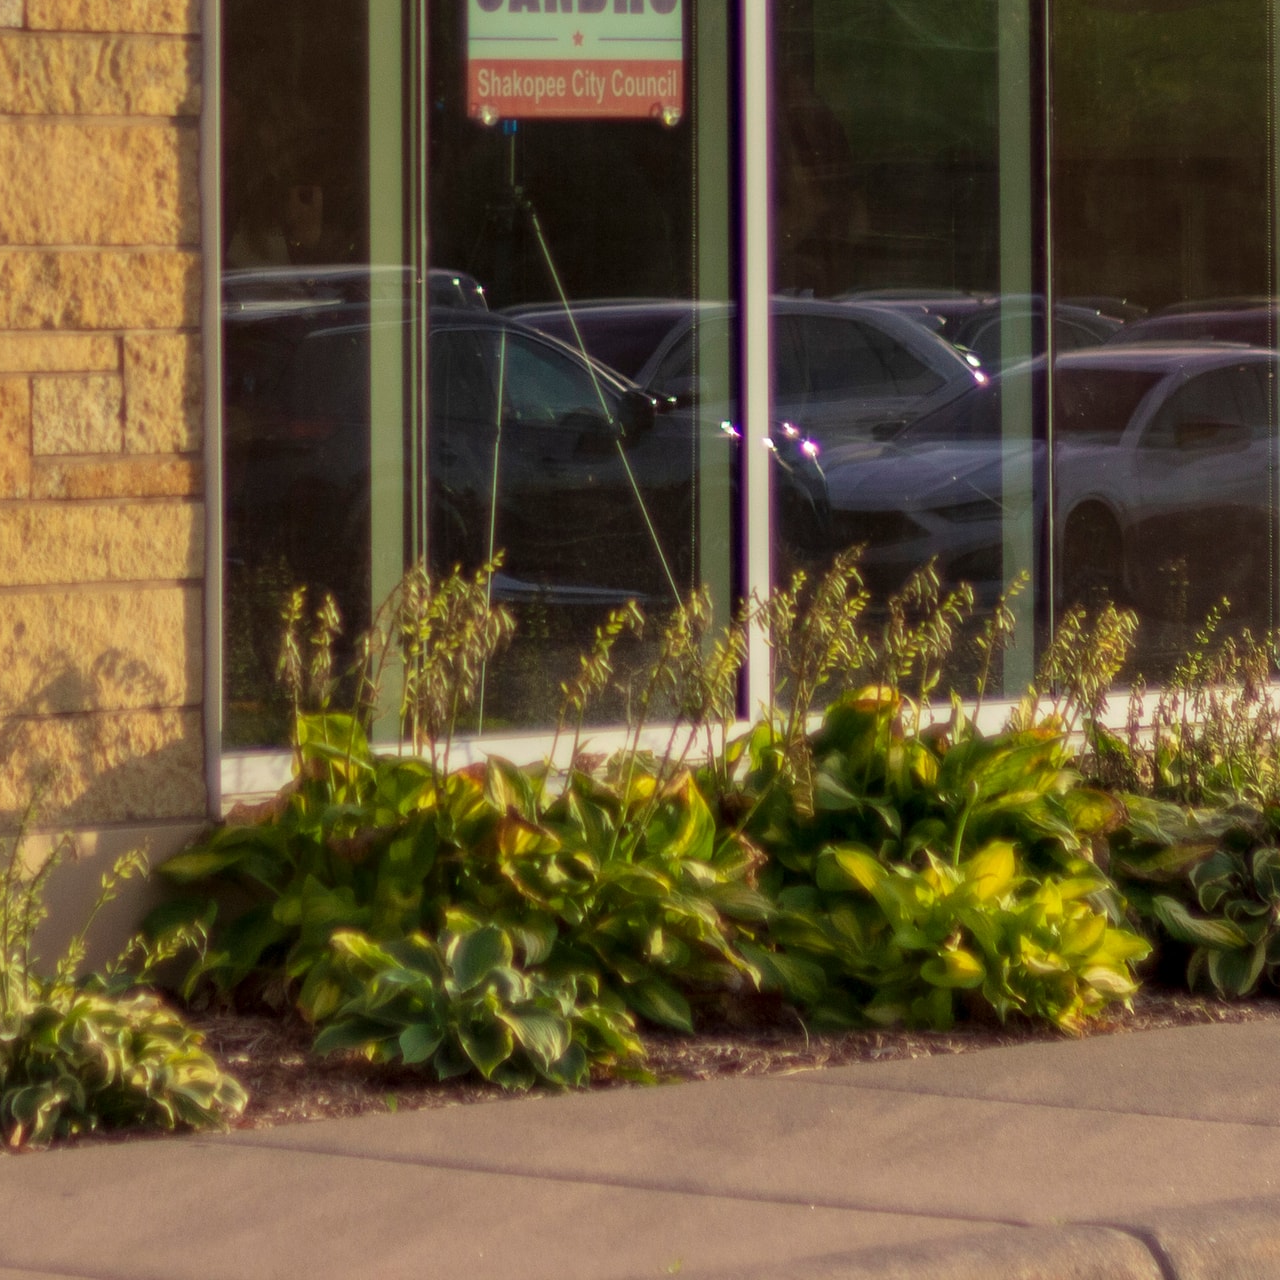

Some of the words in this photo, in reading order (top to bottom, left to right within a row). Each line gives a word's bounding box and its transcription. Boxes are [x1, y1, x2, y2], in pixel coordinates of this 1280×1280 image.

[477, 68, 566, 104] Shakopee
[571, 68, 606, 105] City
[610, 69, 678, 97] Council
